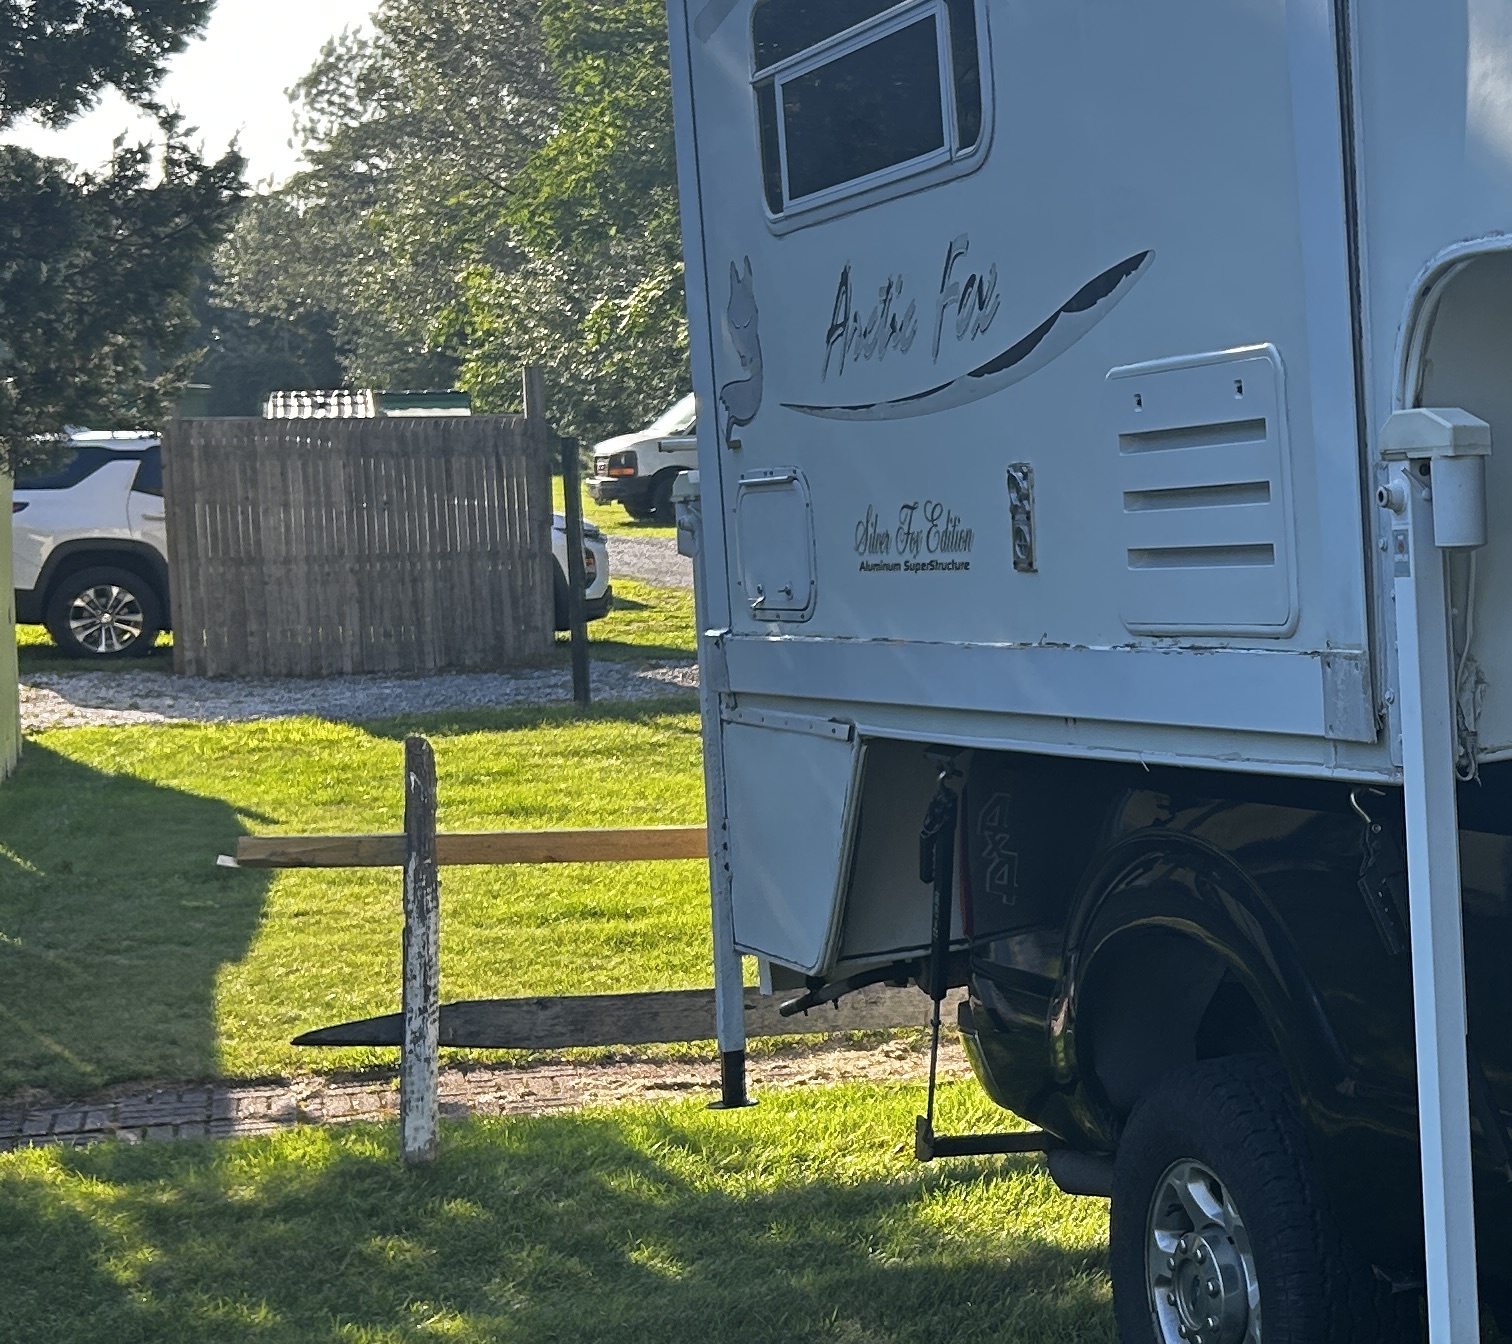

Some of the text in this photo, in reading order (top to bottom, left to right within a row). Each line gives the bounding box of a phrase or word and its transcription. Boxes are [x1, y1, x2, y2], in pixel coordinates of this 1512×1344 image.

[931, 232, 1001, 365] Fox
[853, 500, 976, 558] Silver Fox Edition
[858, 560, 901, 572] Aluminum
